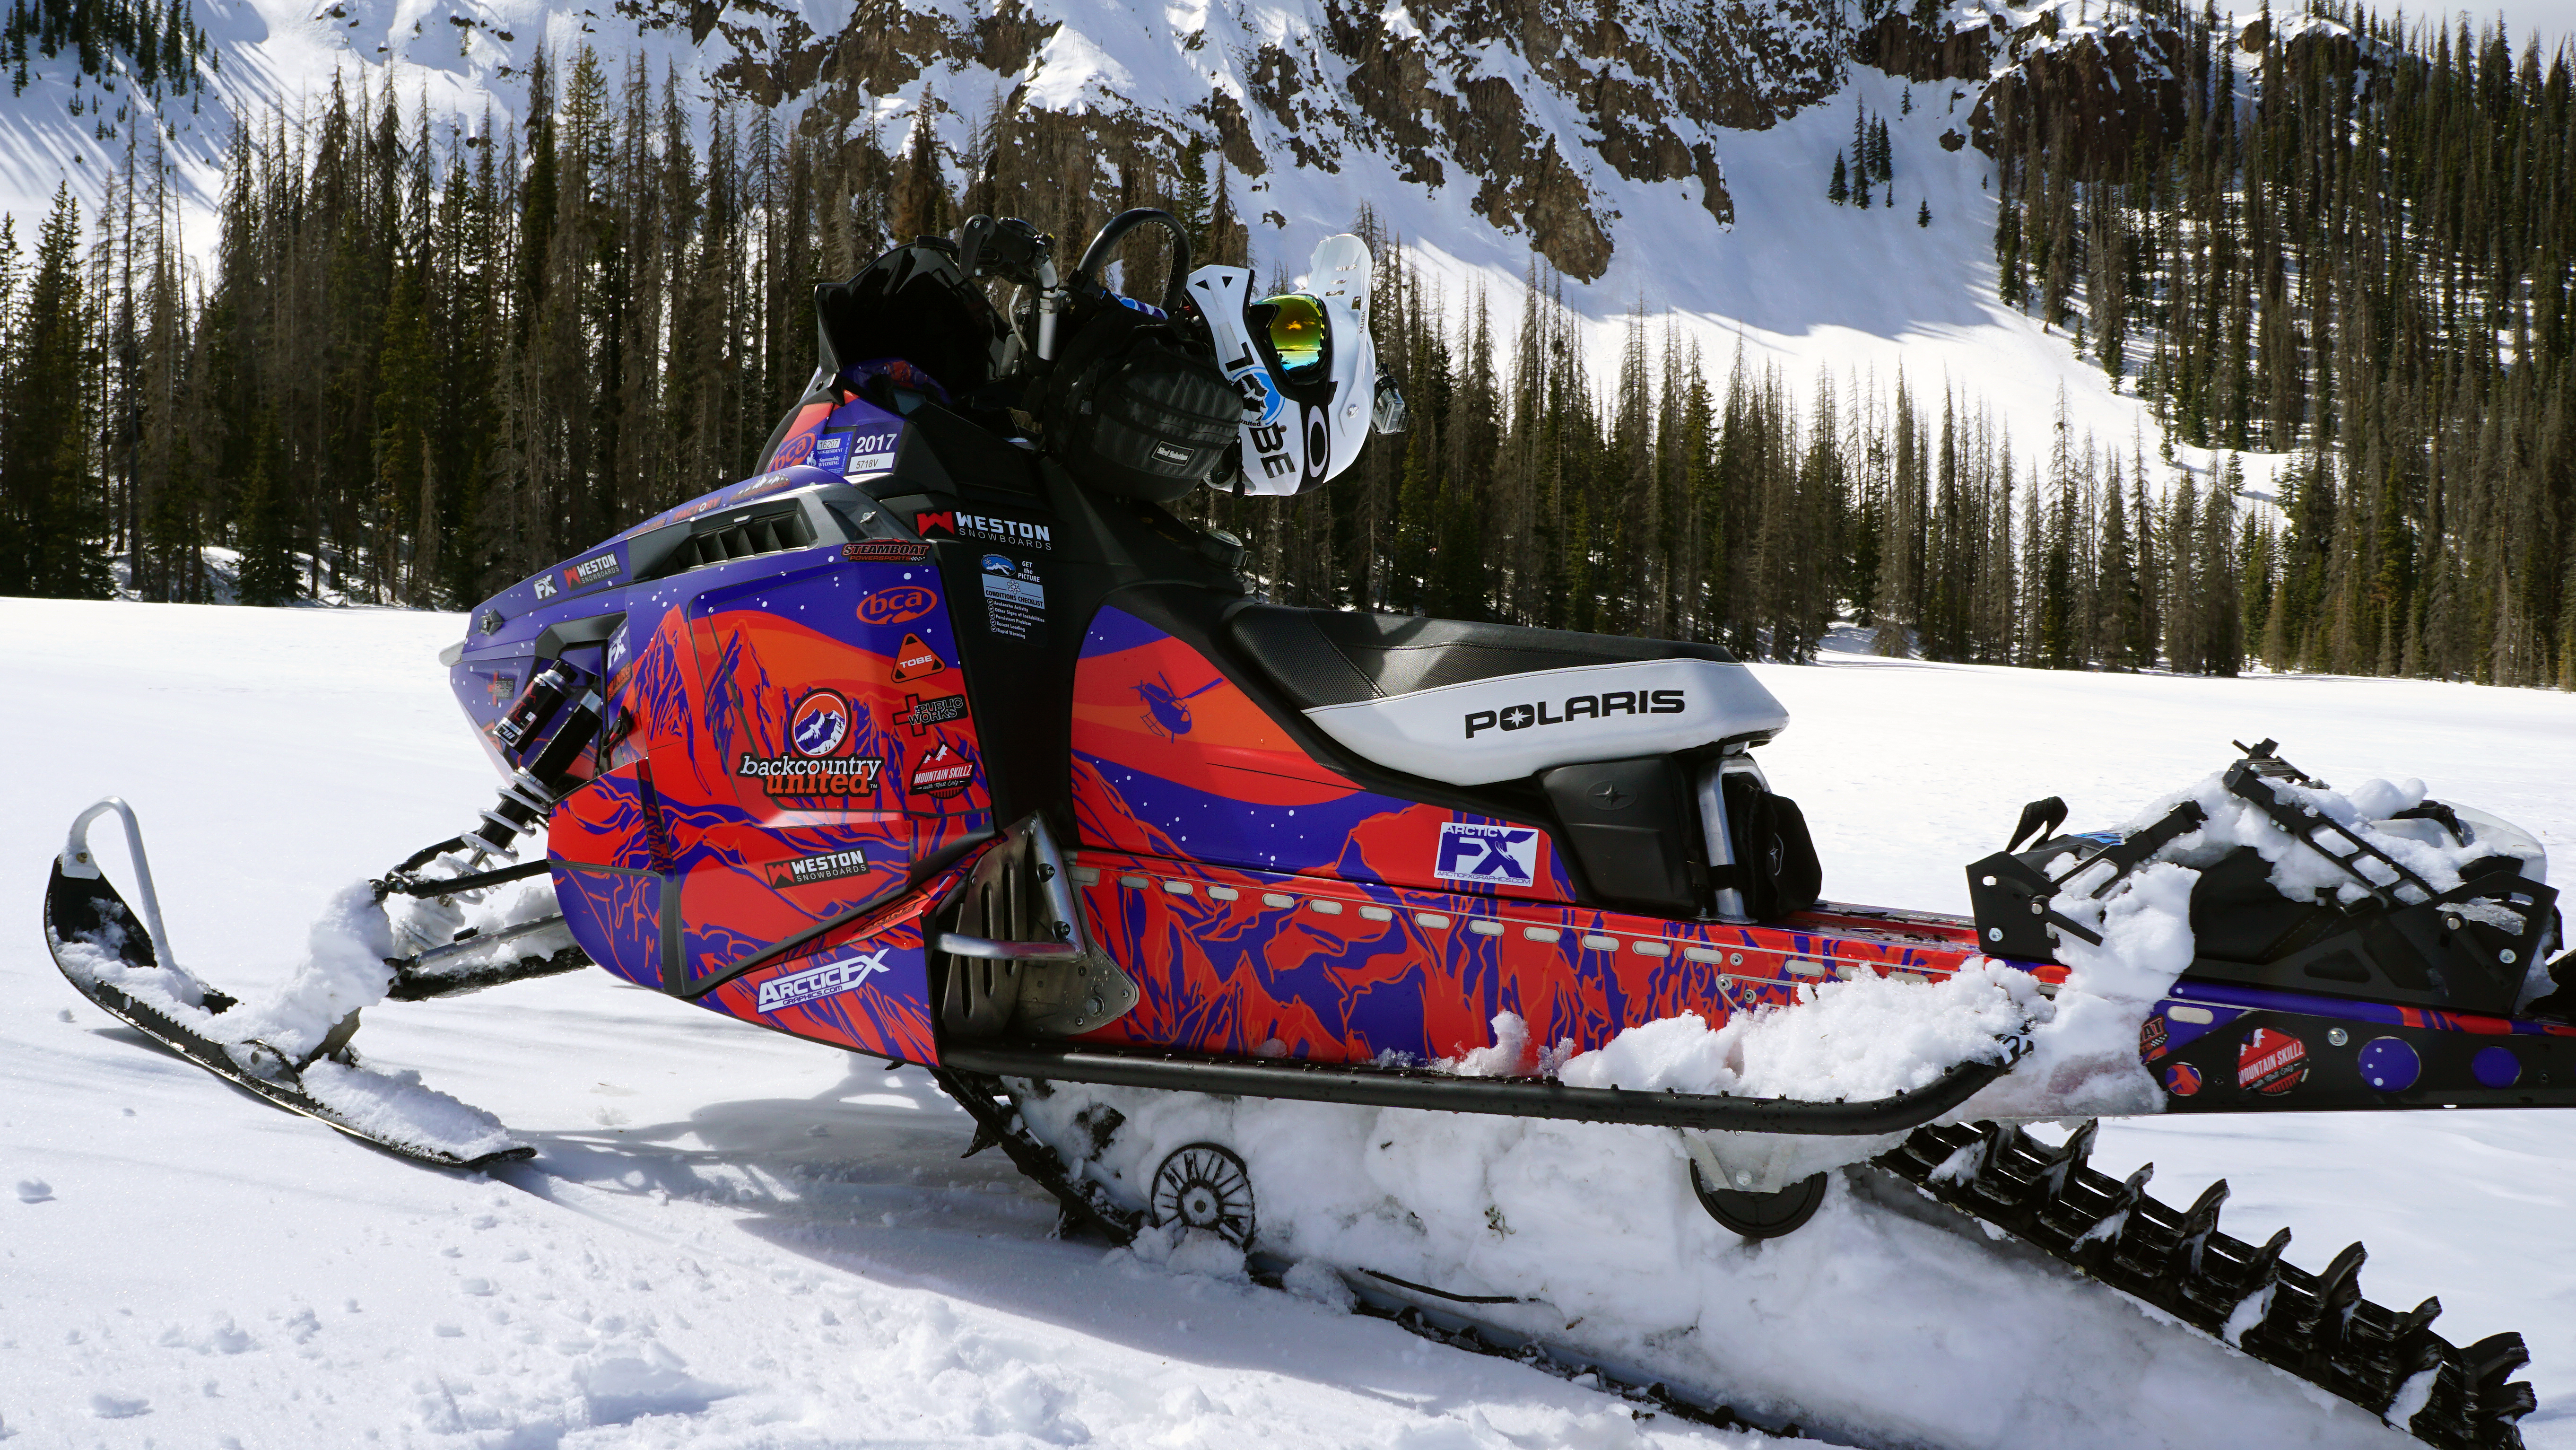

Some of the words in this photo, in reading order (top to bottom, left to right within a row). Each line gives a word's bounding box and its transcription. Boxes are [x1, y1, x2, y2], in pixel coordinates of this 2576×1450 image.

[819, 439, 839, 449] 16207
[854, 433, 897, 454] 2017
[774, 438, 806, 471] bca
[856, 459, 879, 469] 5718V
[673, 498, 721, 520] FACTORY
[956, 511, 1050, 542] WESTON
[959, 528, 1052, 550] SNOWBOARDS
[843, 544, 930, 555] STEAMBOAT
[576, 554, 617, 577] WESTON
[581, 566, 620, 584] SNOWBOARDS
[1018, 573, 1040, 583] PICTURE
[534, 574, 557, 600] FX
[870, 592, 922, 615] bca
[985, 590, 1017, 601] CONDITIONS
[1018, 596, 1043, 607] CHECKLIST
[994, 601, 1014, 609] Avalanche
[1014, 604, 1028, 613] Activity
[995, 614, 1015, 622] Persistent
[1009, 630, 1026, 639] Warming
[1010, 624, 1026, 633] Loading
[899, 655, 932, 669] TOBE
[918, 697, 964, 713] PUBLIC
[908, 708, 957, 725] WORKS
[1465, 690, 1685, 739] POLARIS
[740, 755, 881, 781] backcountry
[914, 769, 949, 784] MOUNTAIN
[949, 765, 973, 779] SKILLZ
[766, 766, 870, 794] united
[1443, 825, 1498, 837] ARCTIC
[791, 850, 864, 874] WESTON
[1438, 830, 1535, 879] FX
[796, 864, 867, 882] SNOWBOARDS
[1437, 871, 1531, 884] ARCTICFXGRAPHICS.COM
[783, 985, 843, 1006] GRAPHICS.COM
[2237, 1057, 2277, 1084] MOUNTAIN
[2277, 1041, 2304, 1064] SKILLZ
